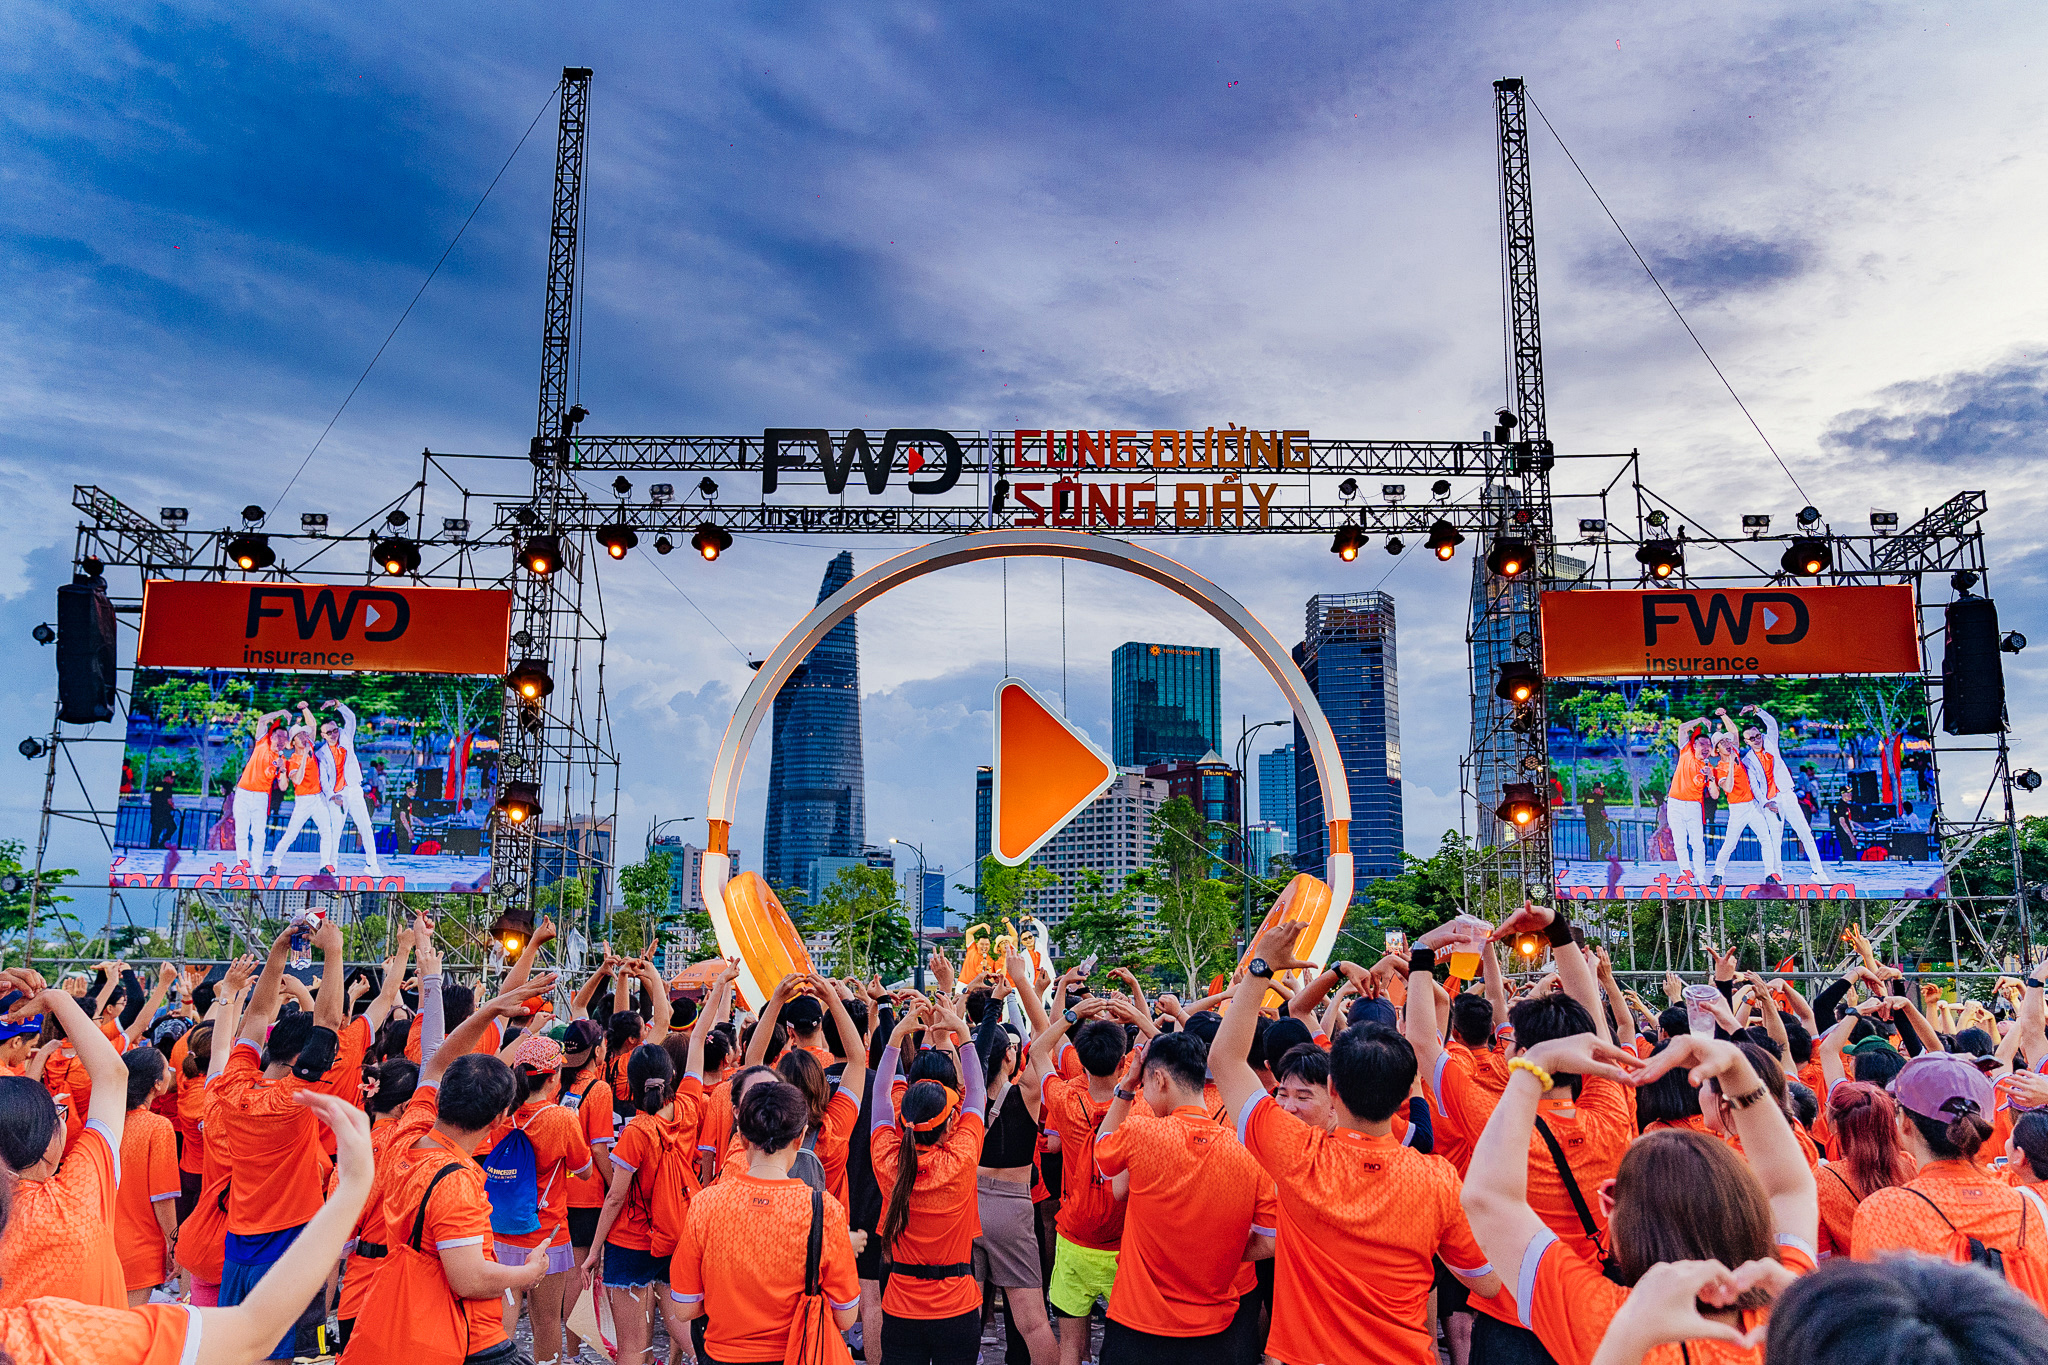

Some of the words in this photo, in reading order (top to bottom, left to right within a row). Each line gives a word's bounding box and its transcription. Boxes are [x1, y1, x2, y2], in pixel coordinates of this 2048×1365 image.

[1014, 429, 1137, 468] CUNG
[1150, 422, 1310, 468] ĐƯỜNG
[763, 428, 963, 495] FWD
[1014, 471, 1156, 527] SỐNG
[1174, 472, 1279, 527] ĐẦY
[761, 502, 897, 526] insurance
[245, 587, 411, 642] FWD
[1642, 593, 1810, 646] FWD
[243, 644, 354, 666] insurance
[1645, 652, 1759, 672] insurance
[1363, 1162, 1381, 1171] FWD
[752, 1197, 770, 1206] FWD
[1962, 1189, 1983, 1197] FWD
